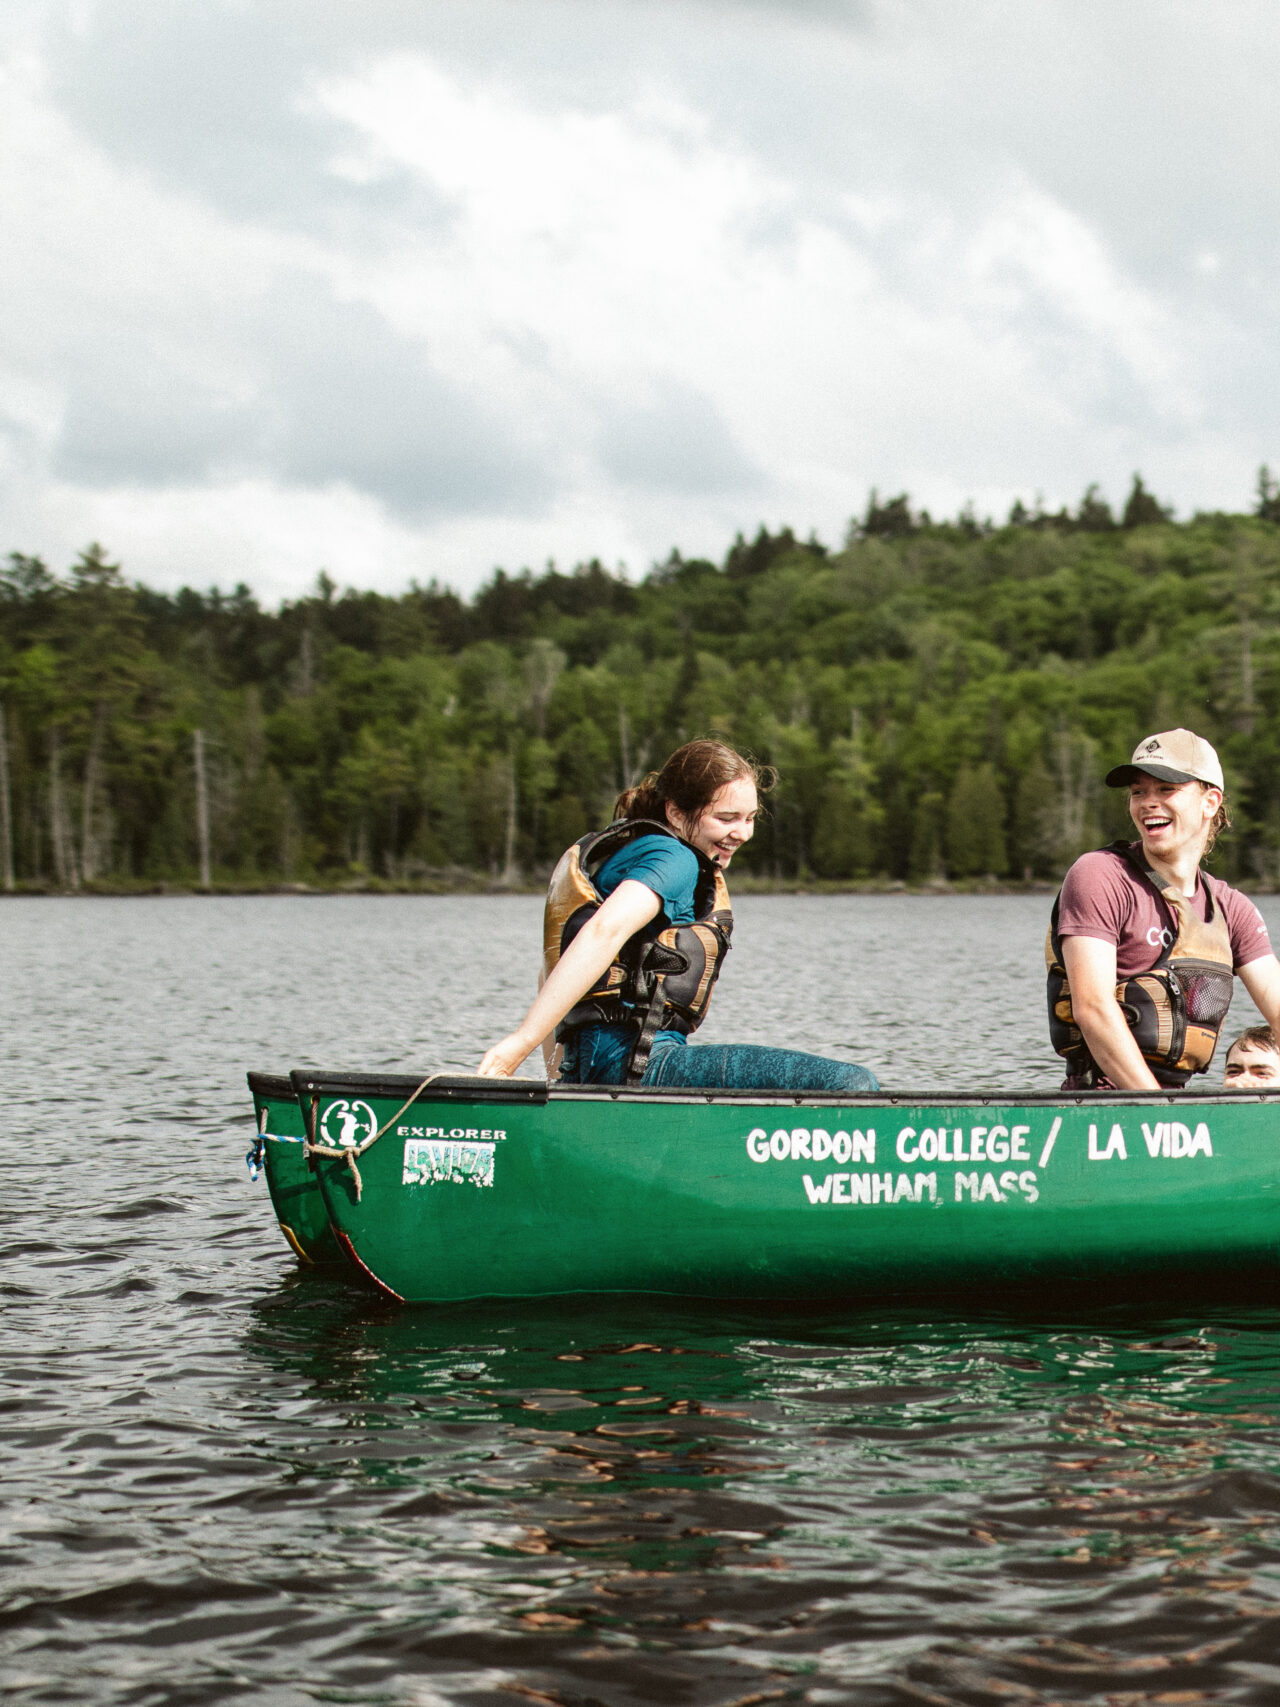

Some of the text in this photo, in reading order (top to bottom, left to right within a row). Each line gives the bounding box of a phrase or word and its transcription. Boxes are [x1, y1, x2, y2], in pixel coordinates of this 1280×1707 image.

[396, 1126, 507, 1140] EXPLORER
[746, 1128, 876, 1164] GORDON
[1087, 1123, 1128, 1160] LA
[1140, 1122, 1213, 1158] VIDA
[954, 1170, 1040, 1203] MASS
